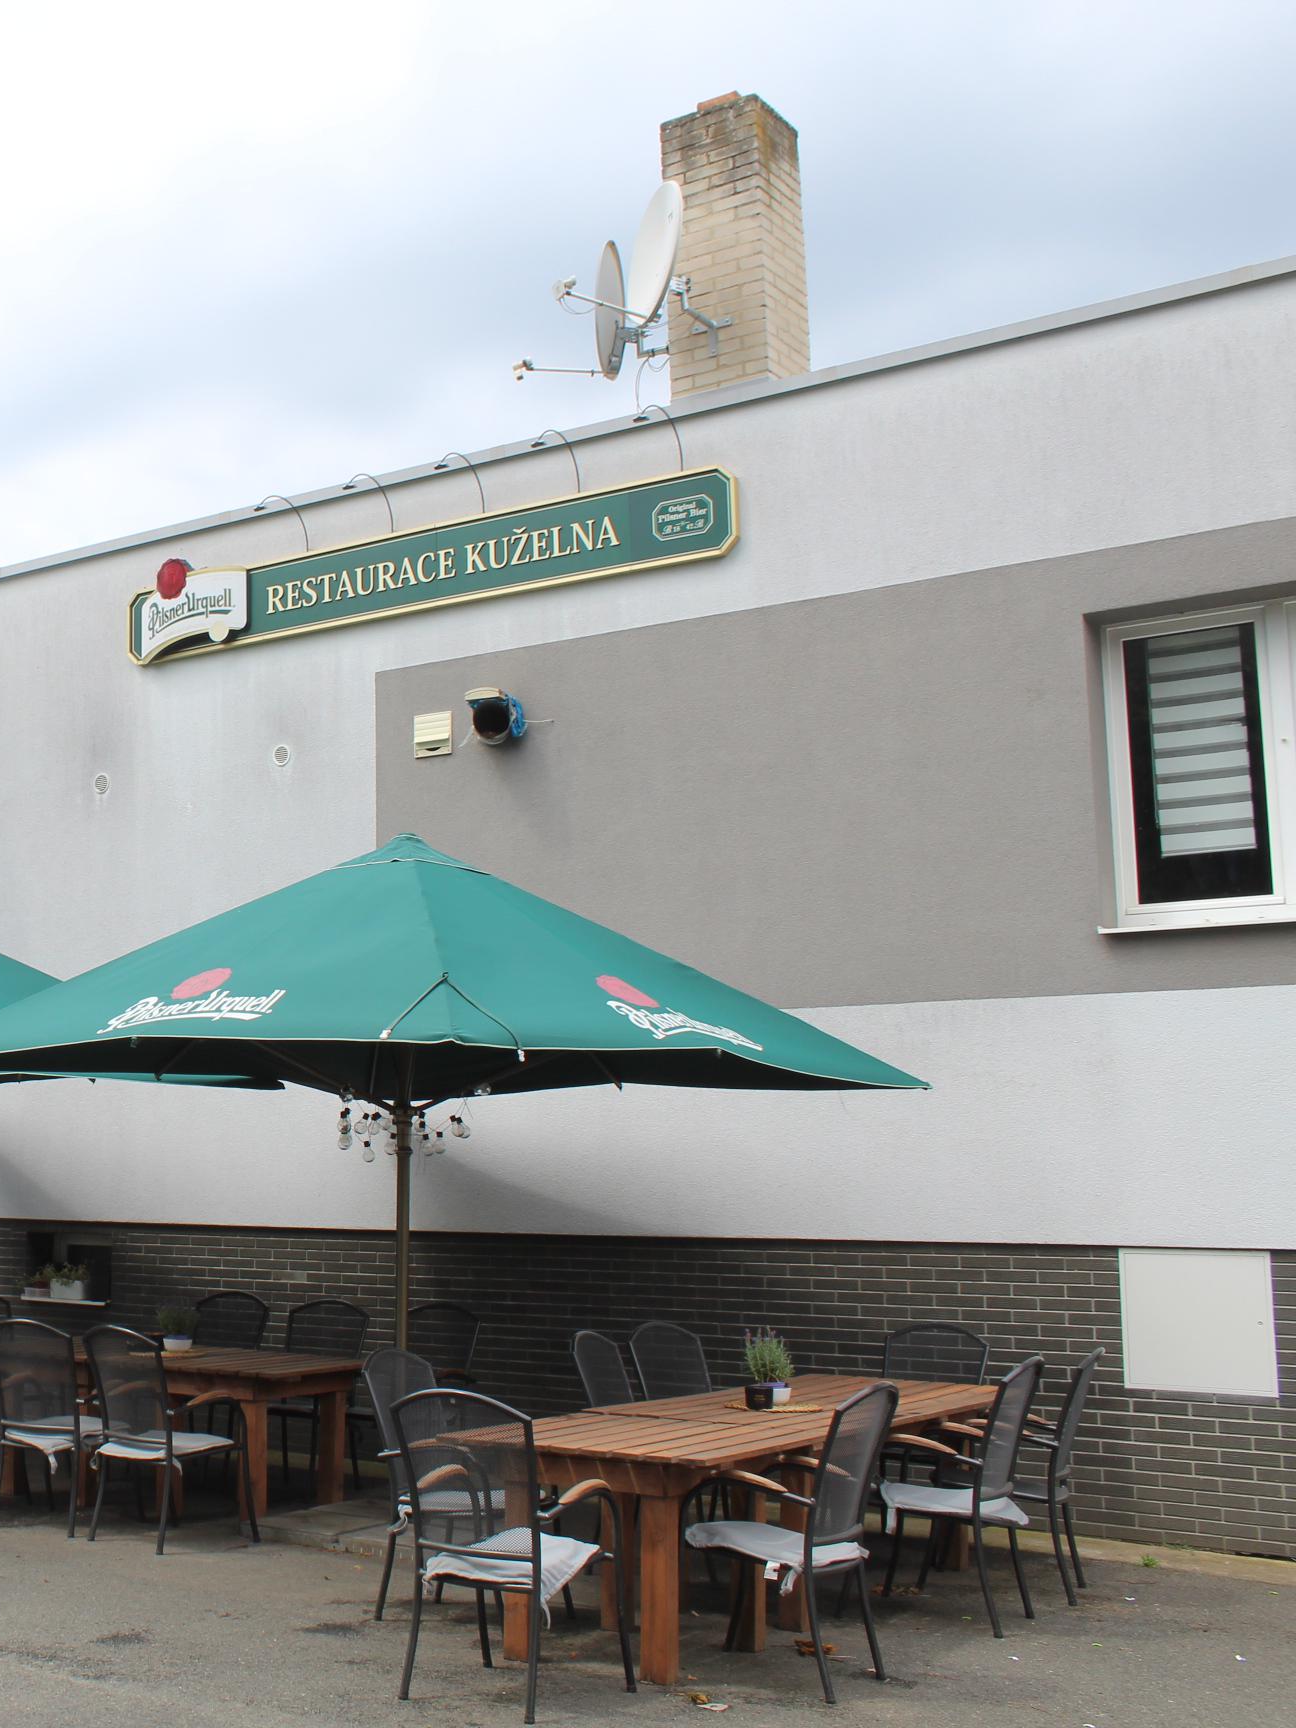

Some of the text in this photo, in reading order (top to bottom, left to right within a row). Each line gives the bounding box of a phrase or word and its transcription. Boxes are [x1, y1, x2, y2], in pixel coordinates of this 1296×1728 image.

[658, 508, 707, 523] Pilsner Bier
[668, 501, 696, 512] Original
[266, 515, 621, 615] RESTAURACE KUŽELNA
[148, 588, 233, 640] Pilsner Urquell
[96, 996, 206, 1035] Pilsner
